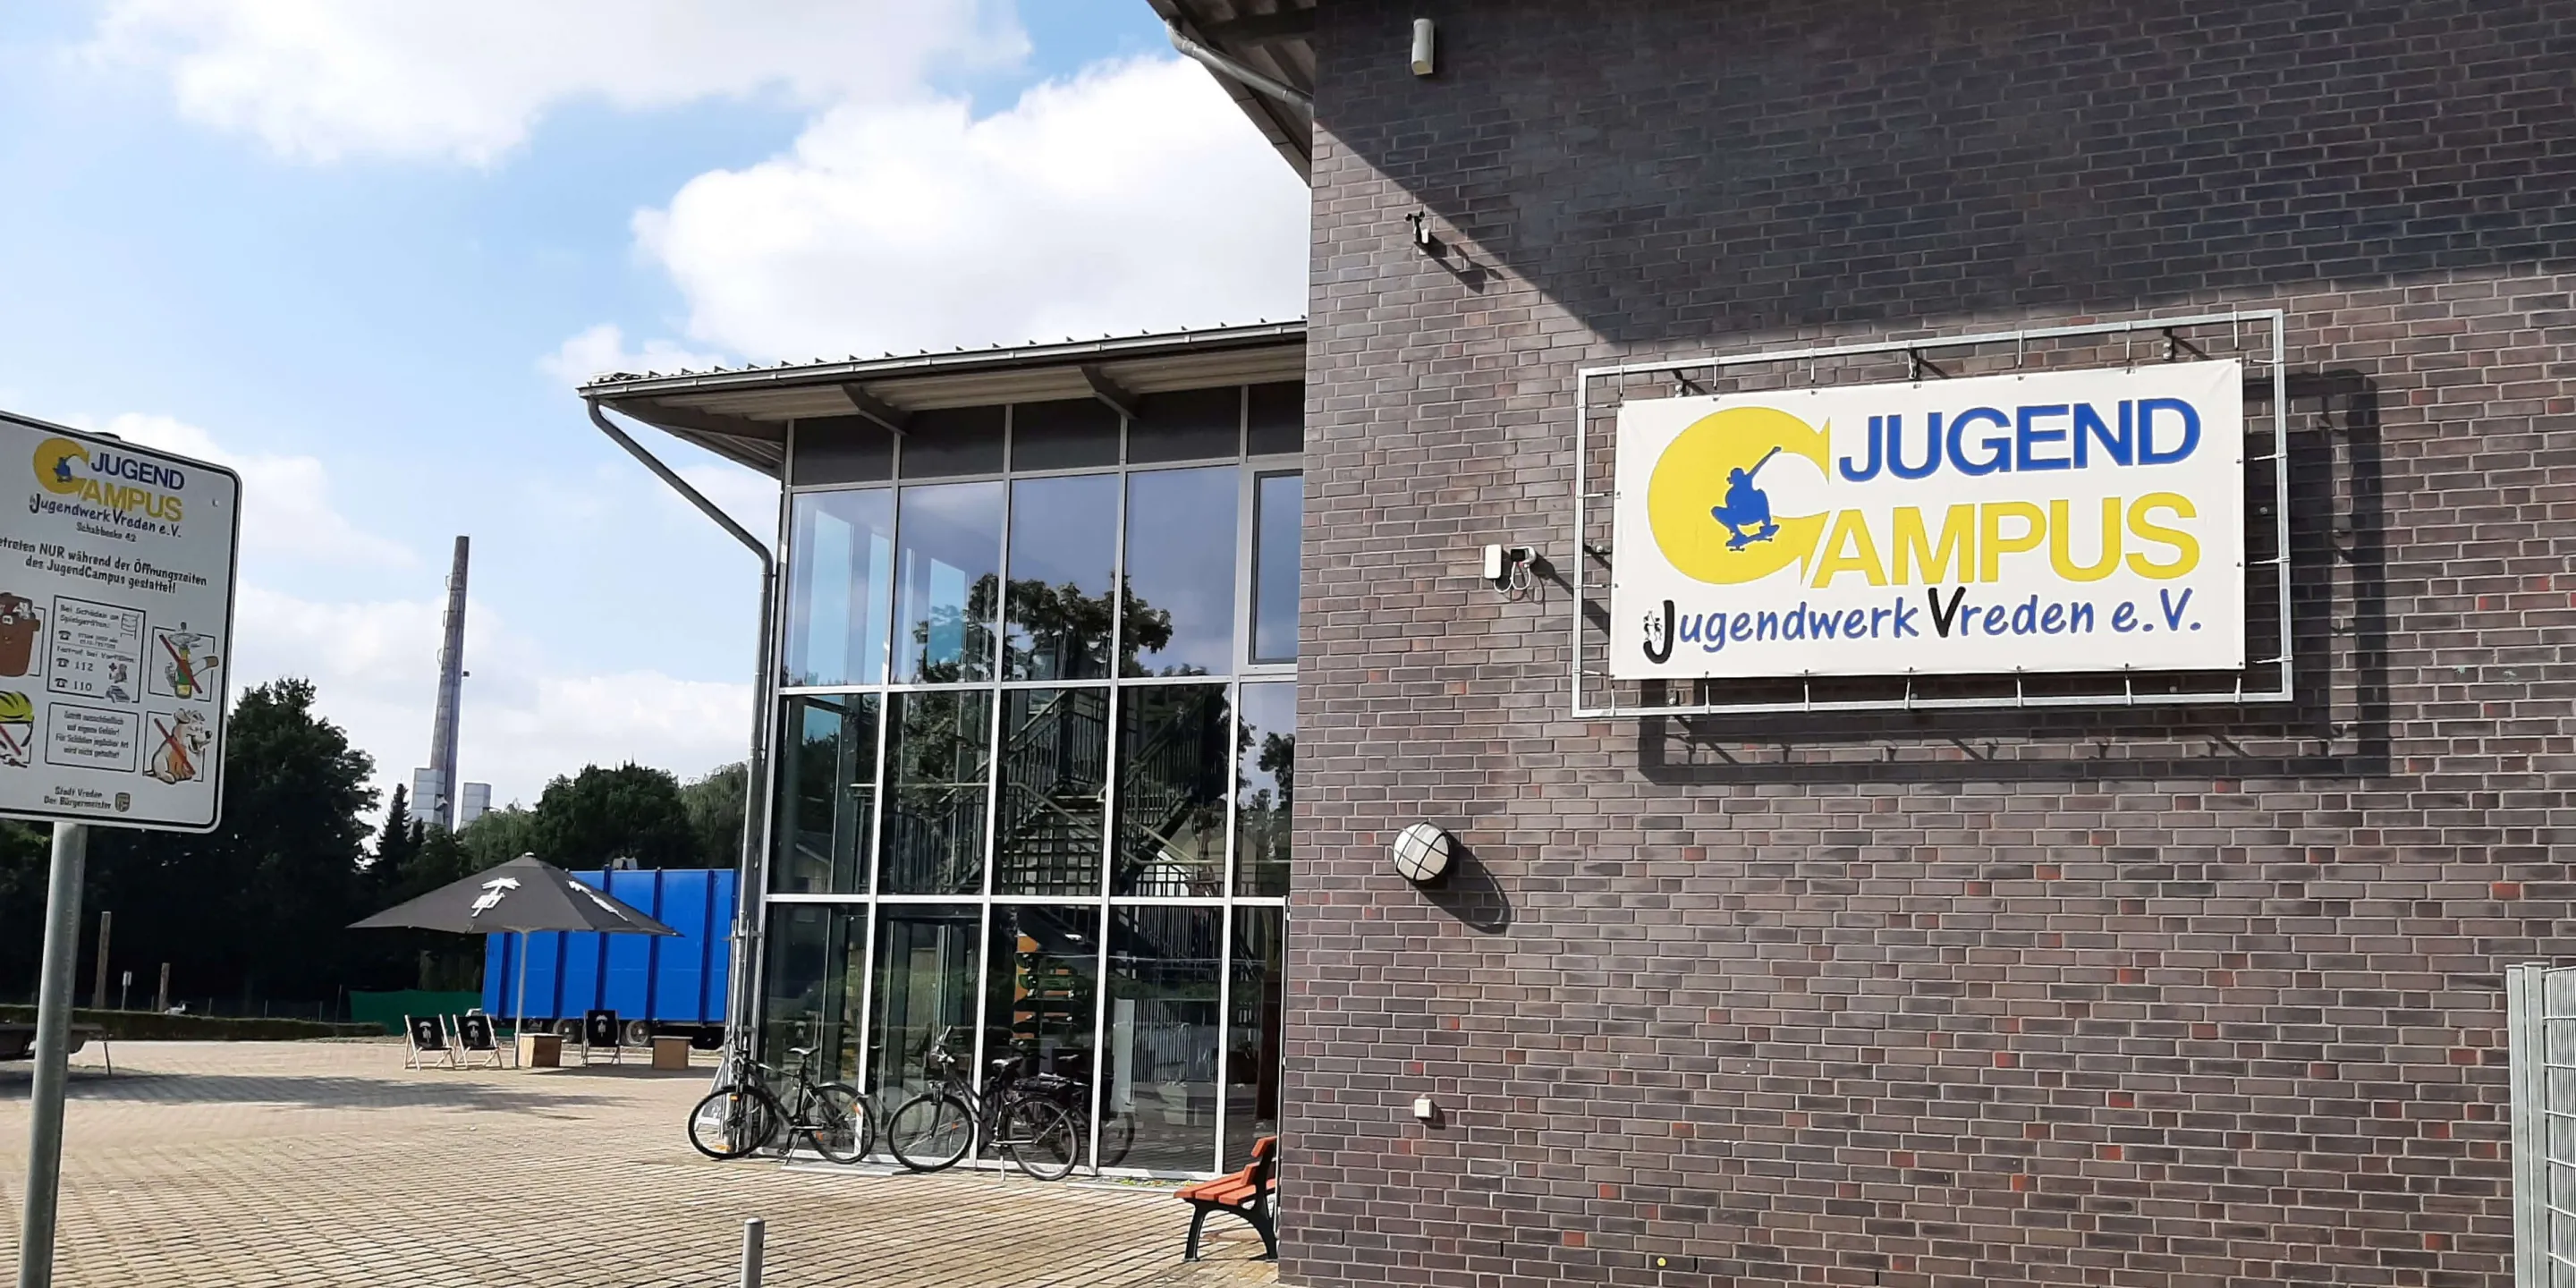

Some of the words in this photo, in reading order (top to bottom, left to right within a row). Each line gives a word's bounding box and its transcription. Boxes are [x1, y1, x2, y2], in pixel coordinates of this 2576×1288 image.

[1838, 397, 2201, 481] JUGEND
[91, 452, 185, 491] JUGEND
[30, 493, 111, 523] Jugendwerk
[113, 509, 157, 532] Vreden
[159, 523, 182, 538] e.V.
[25, 555, 44, 570] des
[47, 558, 125, 586] JugendCampus
[128, 575, 176, 593] gestattet!
[39, 543, 64, 558] NUR
[68, 550, 111, 567] während
[114, 556, 131, 572] der
[134, 558, 207, 586] Öffnungszeiten
[1643, 595, 1919, 665] Jugendwerk
[1928, 586, 2095, 638] Vreden
[2110, 588, 2202, 634] e.V.
[74, 662, 94, 673] 112
[74, 681, 92, 691] 110
[55, 786, 75, 795] Stadt
